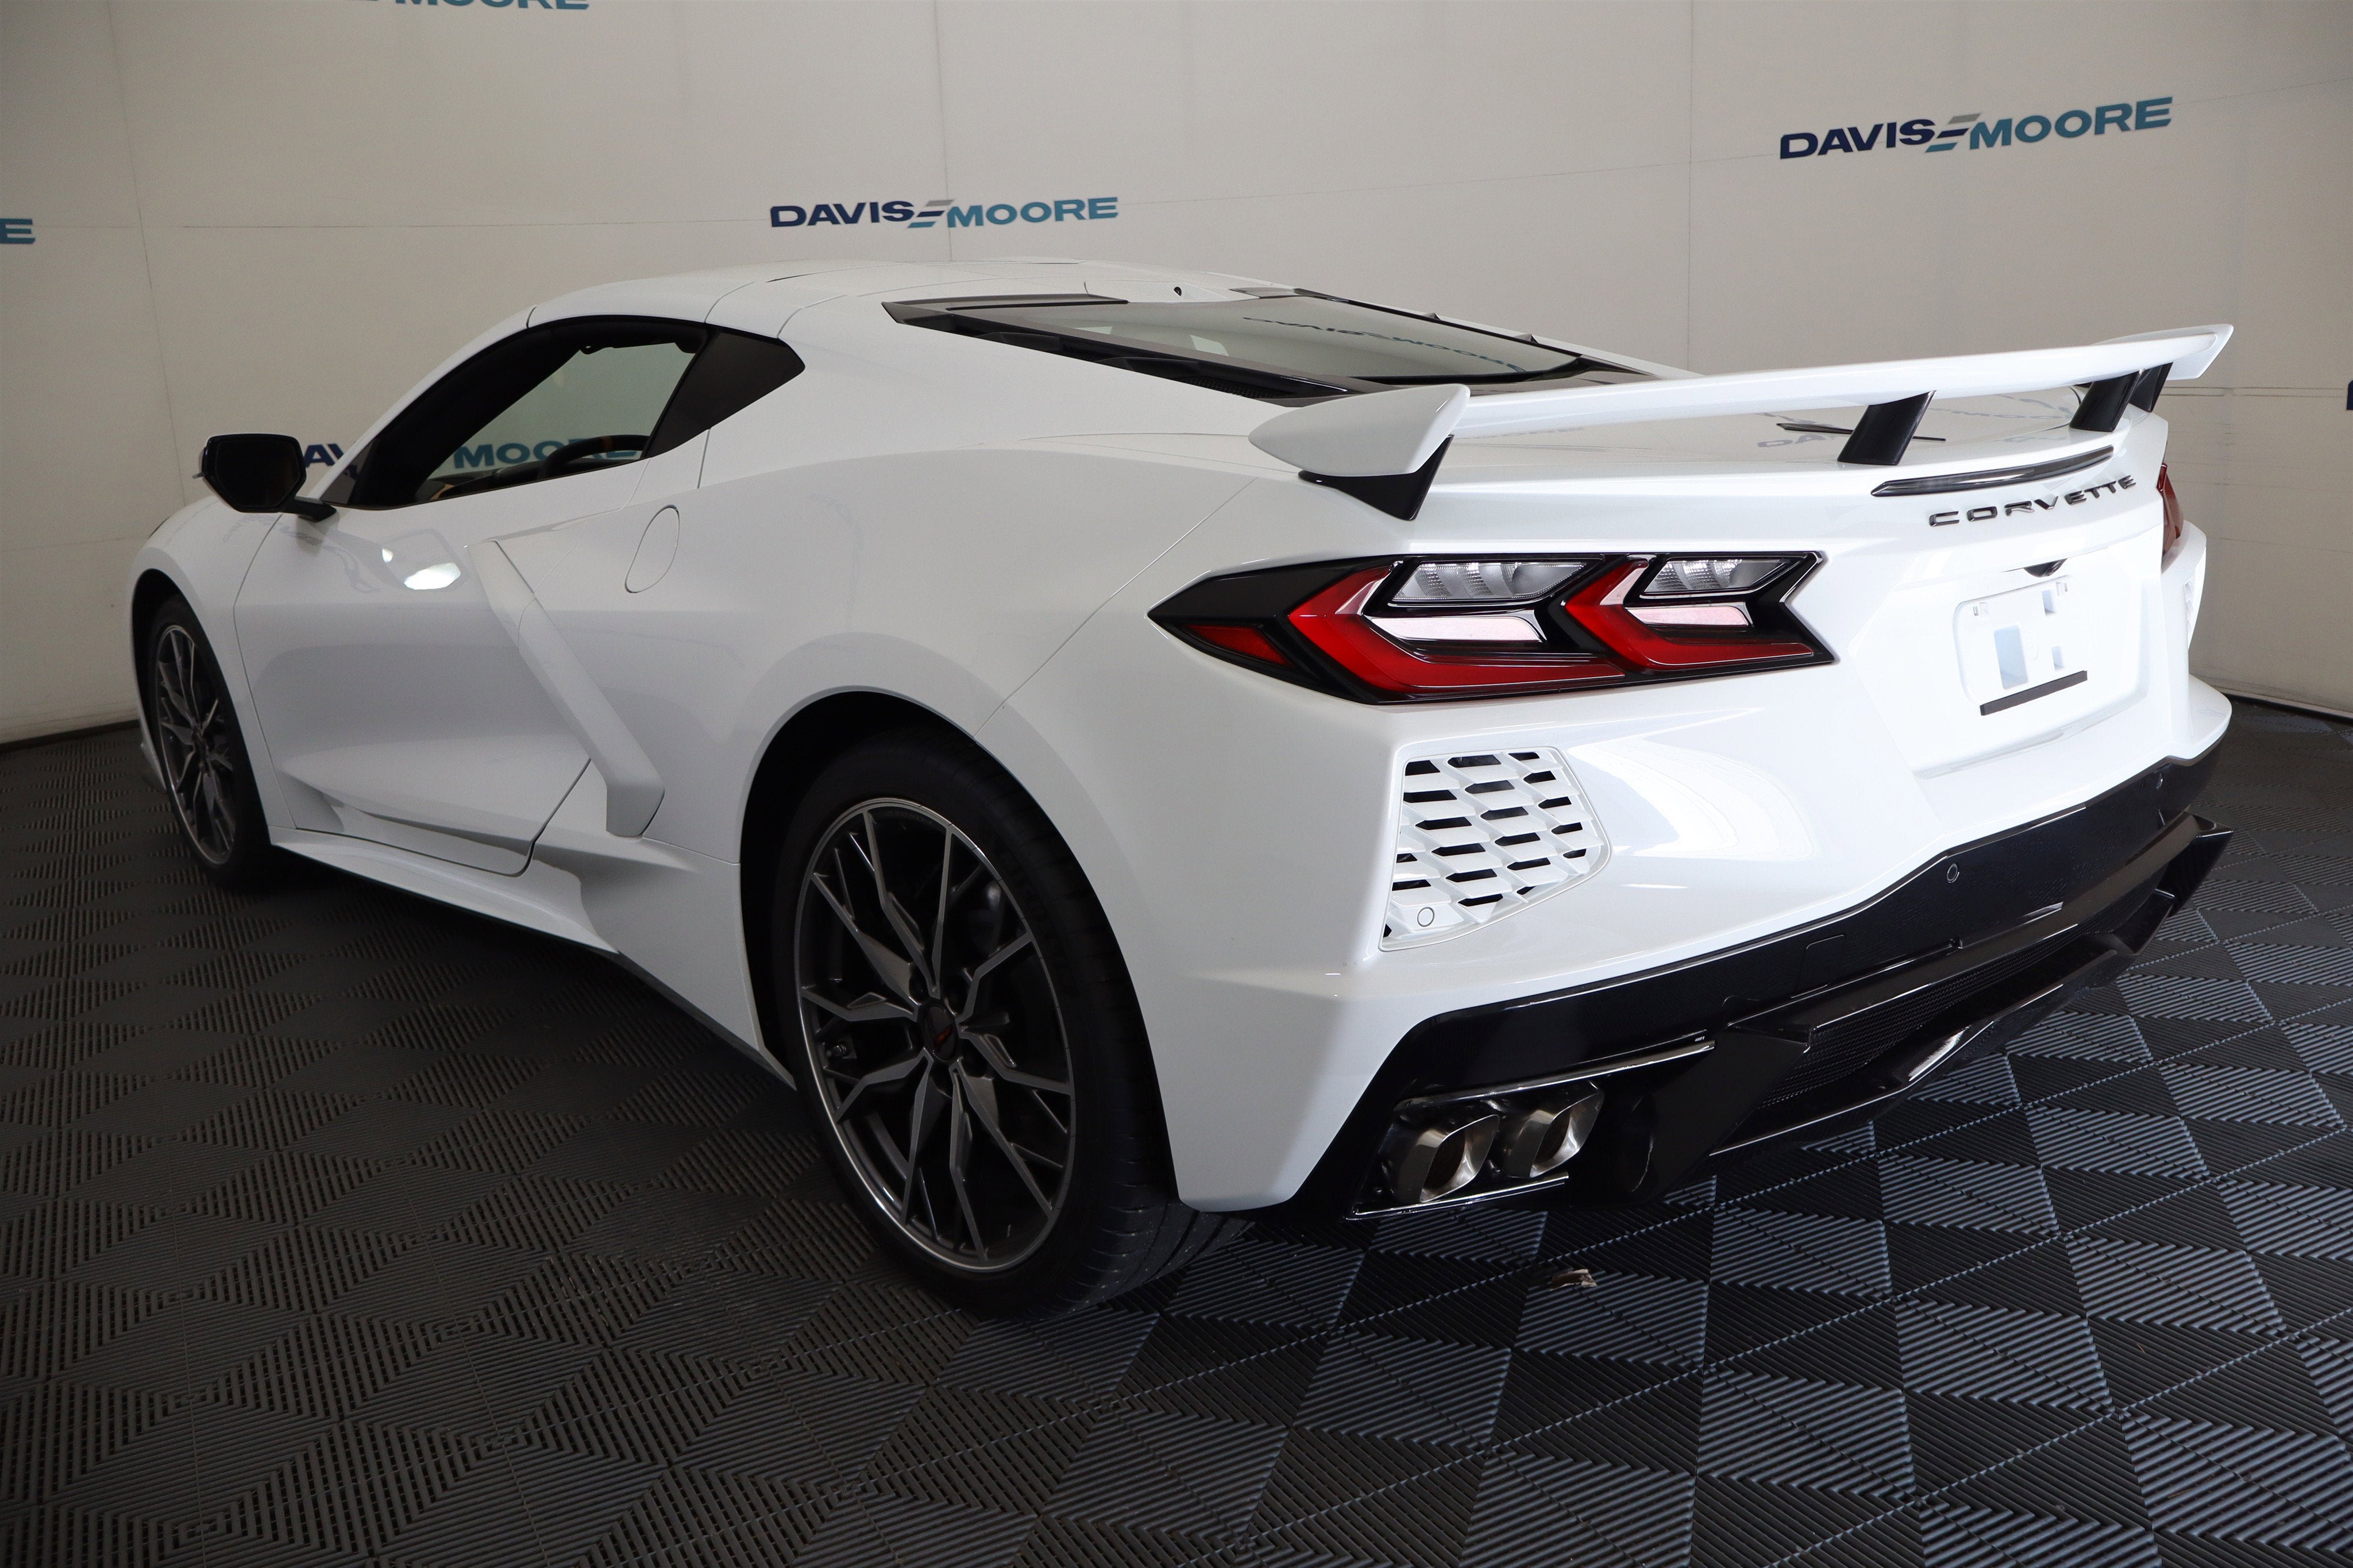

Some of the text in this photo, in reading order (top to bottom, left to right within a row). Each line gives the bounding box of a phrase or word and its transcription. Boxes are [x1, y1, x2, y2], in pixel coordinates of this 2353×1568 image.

[1780, 96, 2172, 159] DAVIS MOORE
[770, 196, 1118, 227] DAVIS MOORE
[454, 438, 638, 469] MOO
[1929, 474, 2136, 527] CORVETTE
